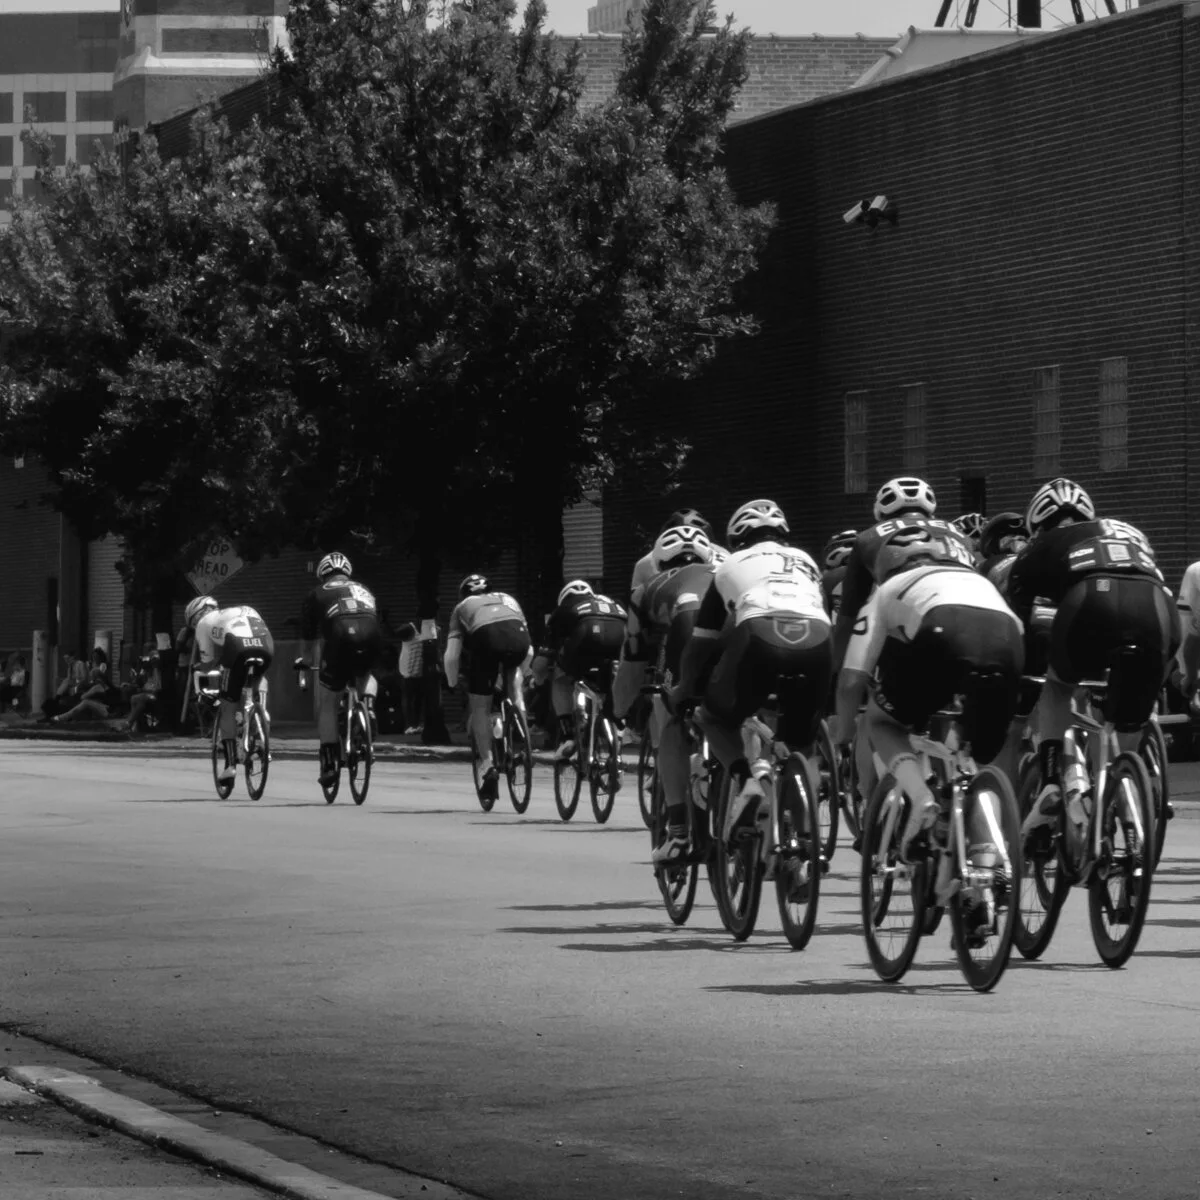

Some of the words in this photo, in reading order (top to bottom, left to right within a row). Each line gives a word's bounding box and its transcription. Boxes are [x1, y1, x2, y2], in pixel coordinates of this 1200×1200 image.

[875, 519, 966, 538] ELIEL
[194, 559, 229, 576] HEAD
[242, 638, 264, 648] ELIEL
